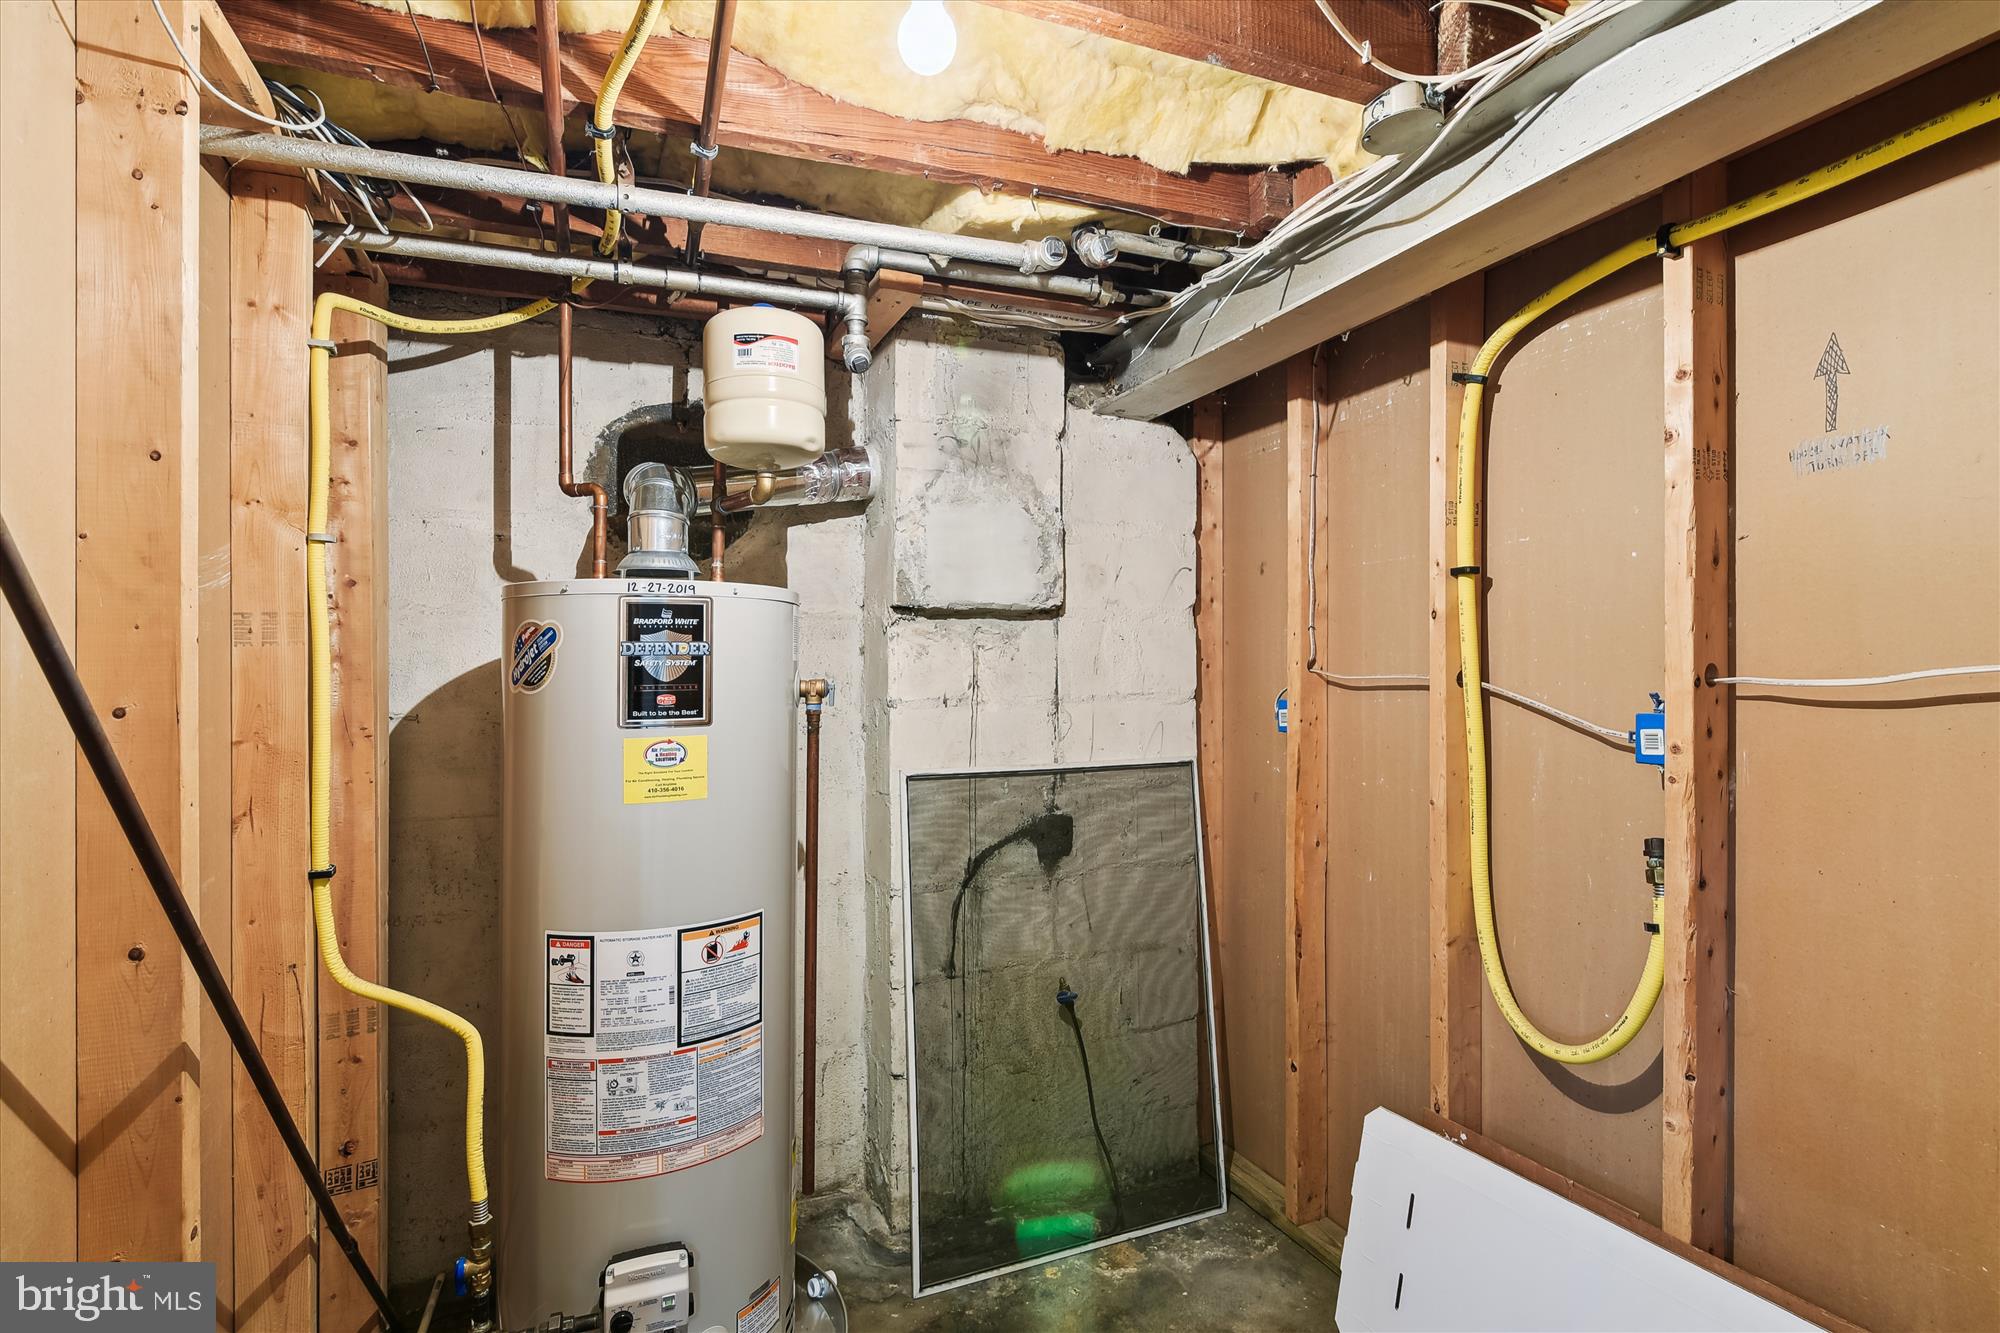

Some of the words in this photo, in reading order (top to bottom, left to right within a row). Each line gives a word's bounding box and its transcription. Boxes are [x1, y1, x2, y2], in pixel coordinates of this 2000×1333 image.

[1830, 427, 1891, 450] WATER
[621, 642, 710, 655] DEFENDER
[715, 925, 739, 934] WARNING
